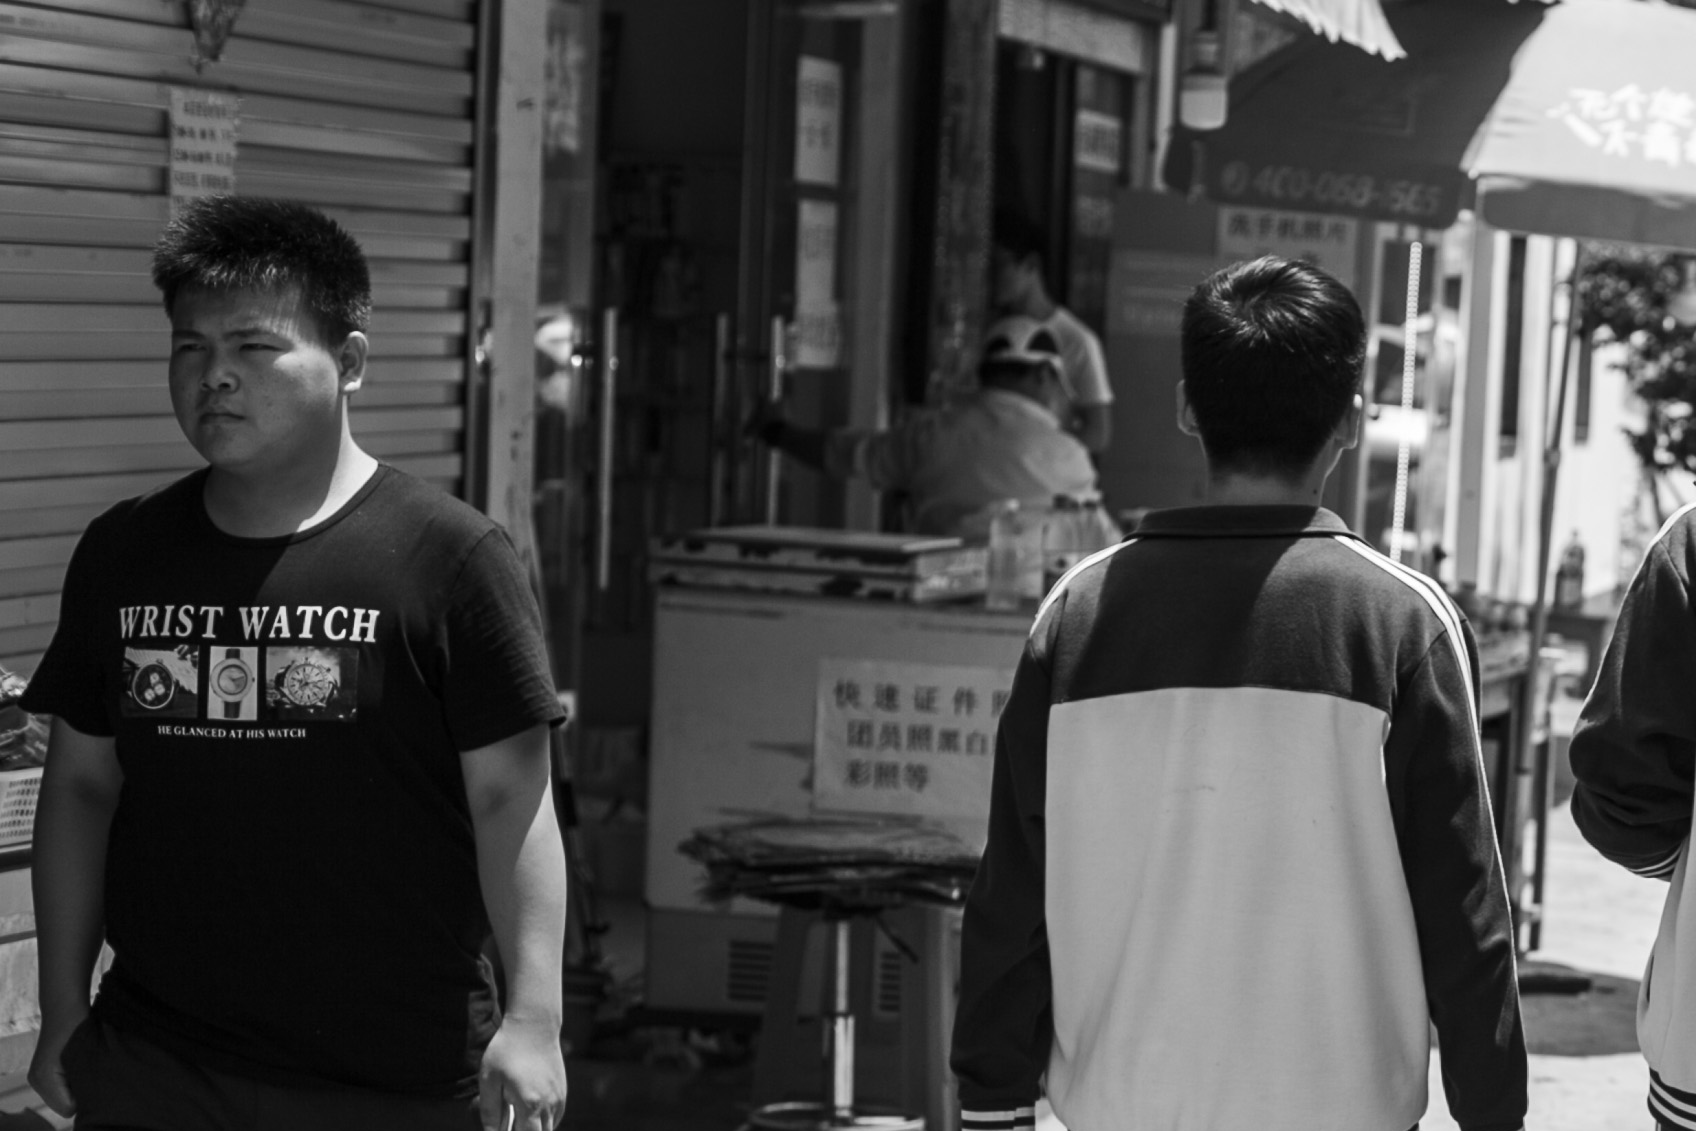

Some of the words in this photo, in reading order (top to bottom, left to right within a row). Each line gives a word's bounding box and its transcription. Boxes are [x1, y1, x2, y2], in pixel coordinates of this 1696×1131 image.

[119, 605, 223, 638] WRIST
[239, 605, 380, 642] WATCH
[157, 725, 173, 736] HE
[174, 726, 226, 739] GLANCED
[228, 729, 244, 739] AT
[246, 729, 265, 740] HIS
[267, 727, 306, 740] WATCH
[846, 720, 996, 754] 团员照黑白
